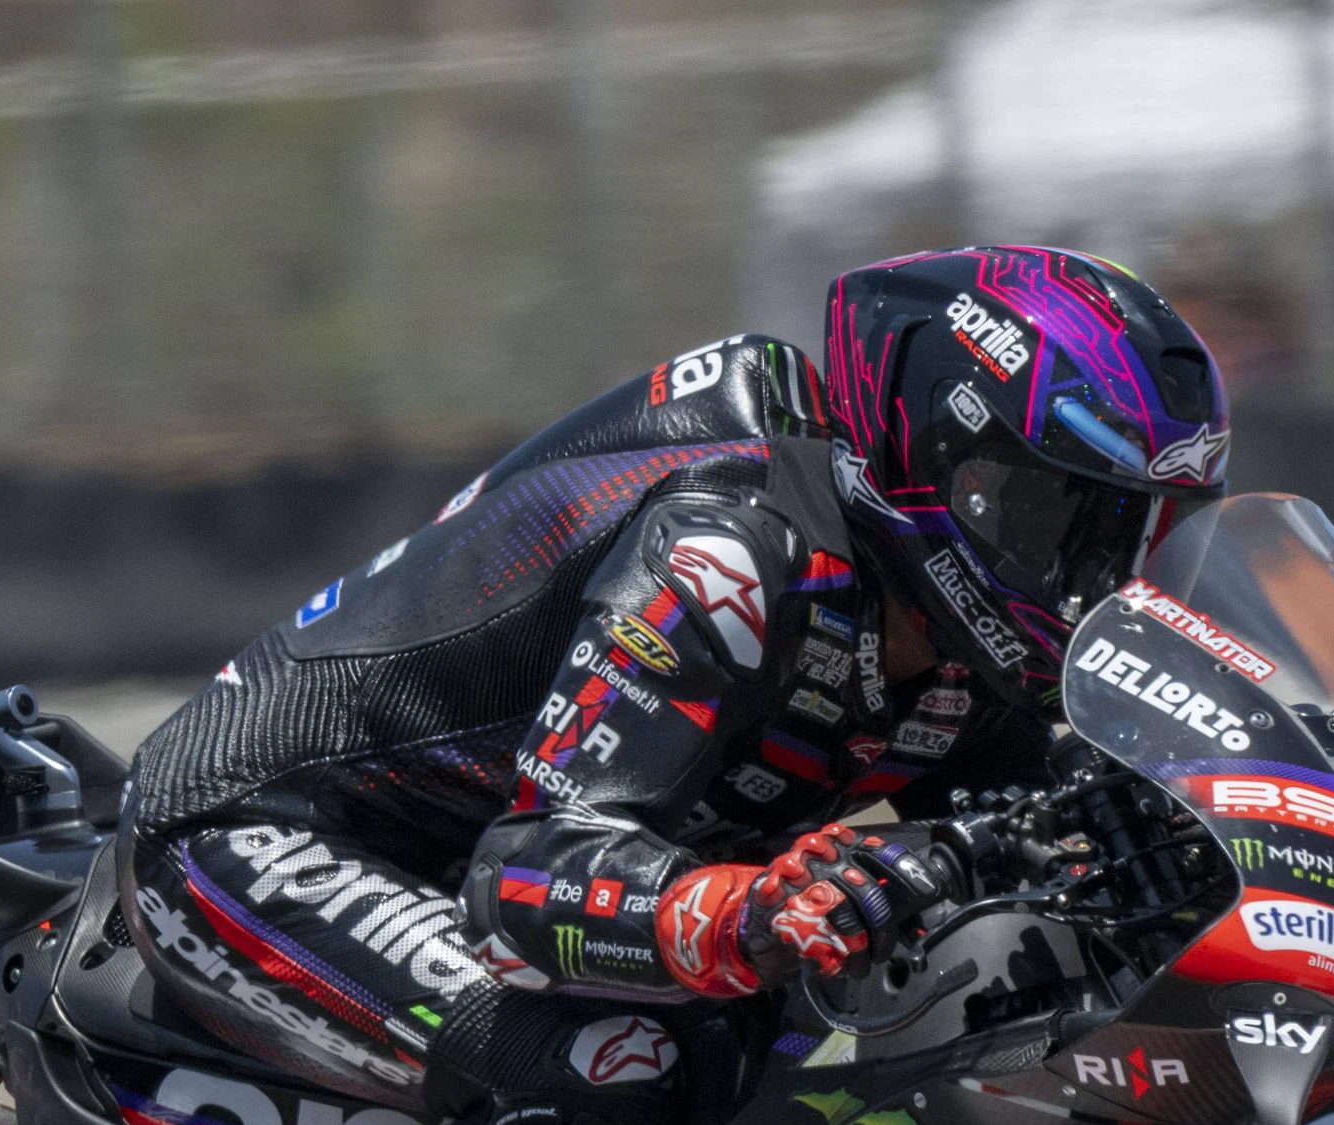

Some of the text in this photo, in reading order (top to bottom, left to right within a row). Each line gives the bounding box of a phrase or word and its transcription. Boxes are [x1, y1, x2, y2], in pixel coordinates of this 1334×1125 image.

[946, 292, 1030, 376] aprilia
[955, 329, 1010, 384] RACING
[954, 392, 985, 424] 100%
[1122, 579, 1275, 682] MARTINATOR
[588, 653, 660, 714] Lifenet.it
[855, 632, 885, 712] aprilia
[517, 749, 583, 799] MARSH
[229, 825, 491, 1002] aprilia
[550, 880, 582, 902] #be
[596, 889, 610, 908] a
[585, 941, 653, 963] MONSTER
[136, 887, 411, 1085] alpinestars
[1231, 1013, 1327, 1055] sky
